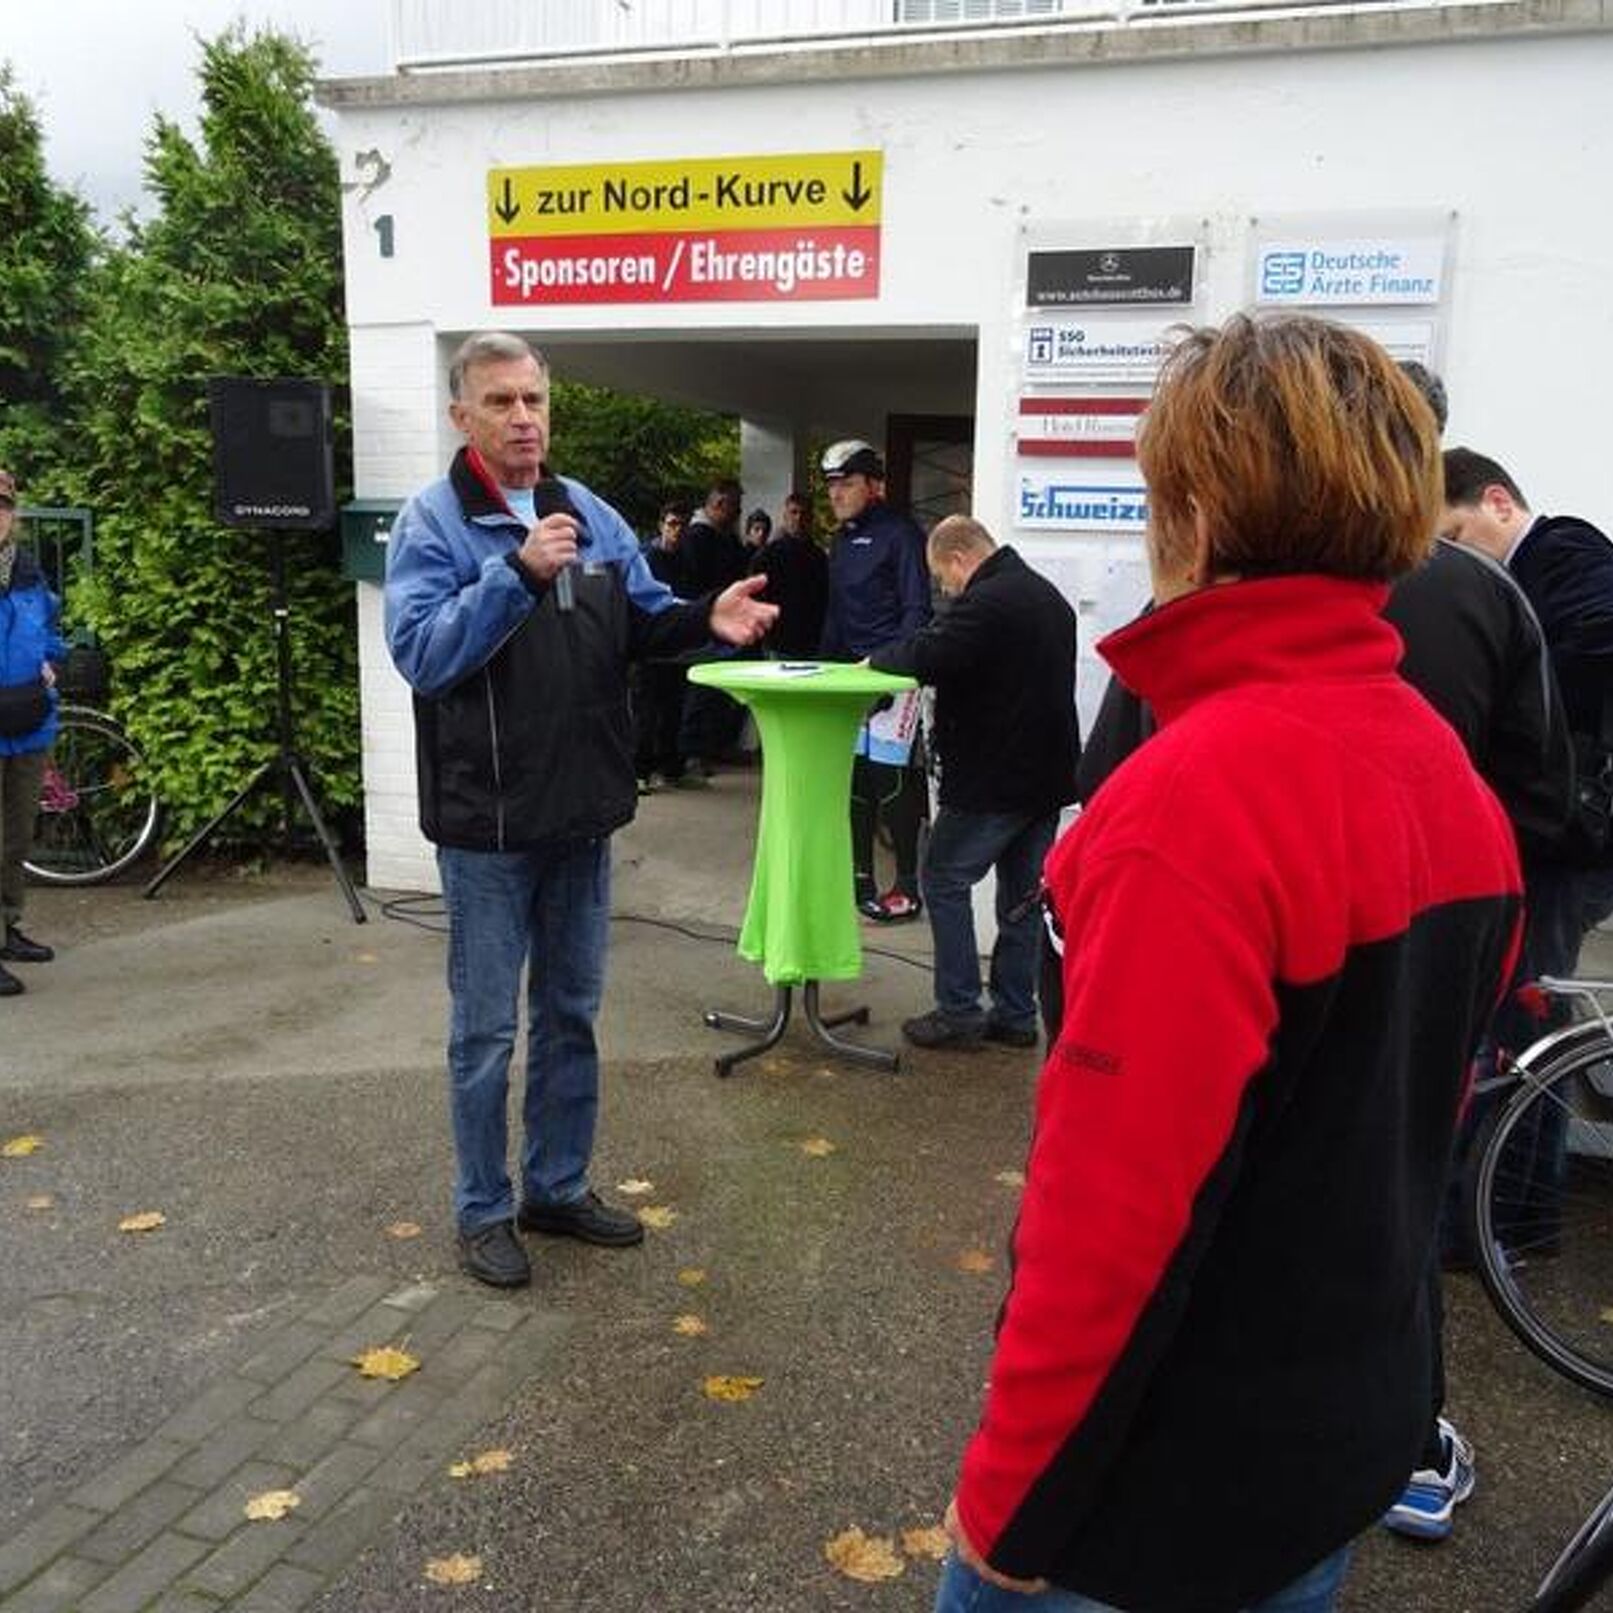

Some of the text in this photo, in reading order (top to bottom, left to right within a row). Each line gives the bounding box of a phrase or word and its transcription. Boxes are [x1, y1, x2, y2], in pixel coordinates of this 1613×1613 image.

[537, 185, 592, 215] zur
[374, 214, 394, 259] 1
[504, 247, 655, 298] Sponsoren
[690, 238, 865, 292] Ehrengäste
[1311, 251, 1401, 270] Deutsche
[1311, 271, 1434, 294] Ärzte Finanz
